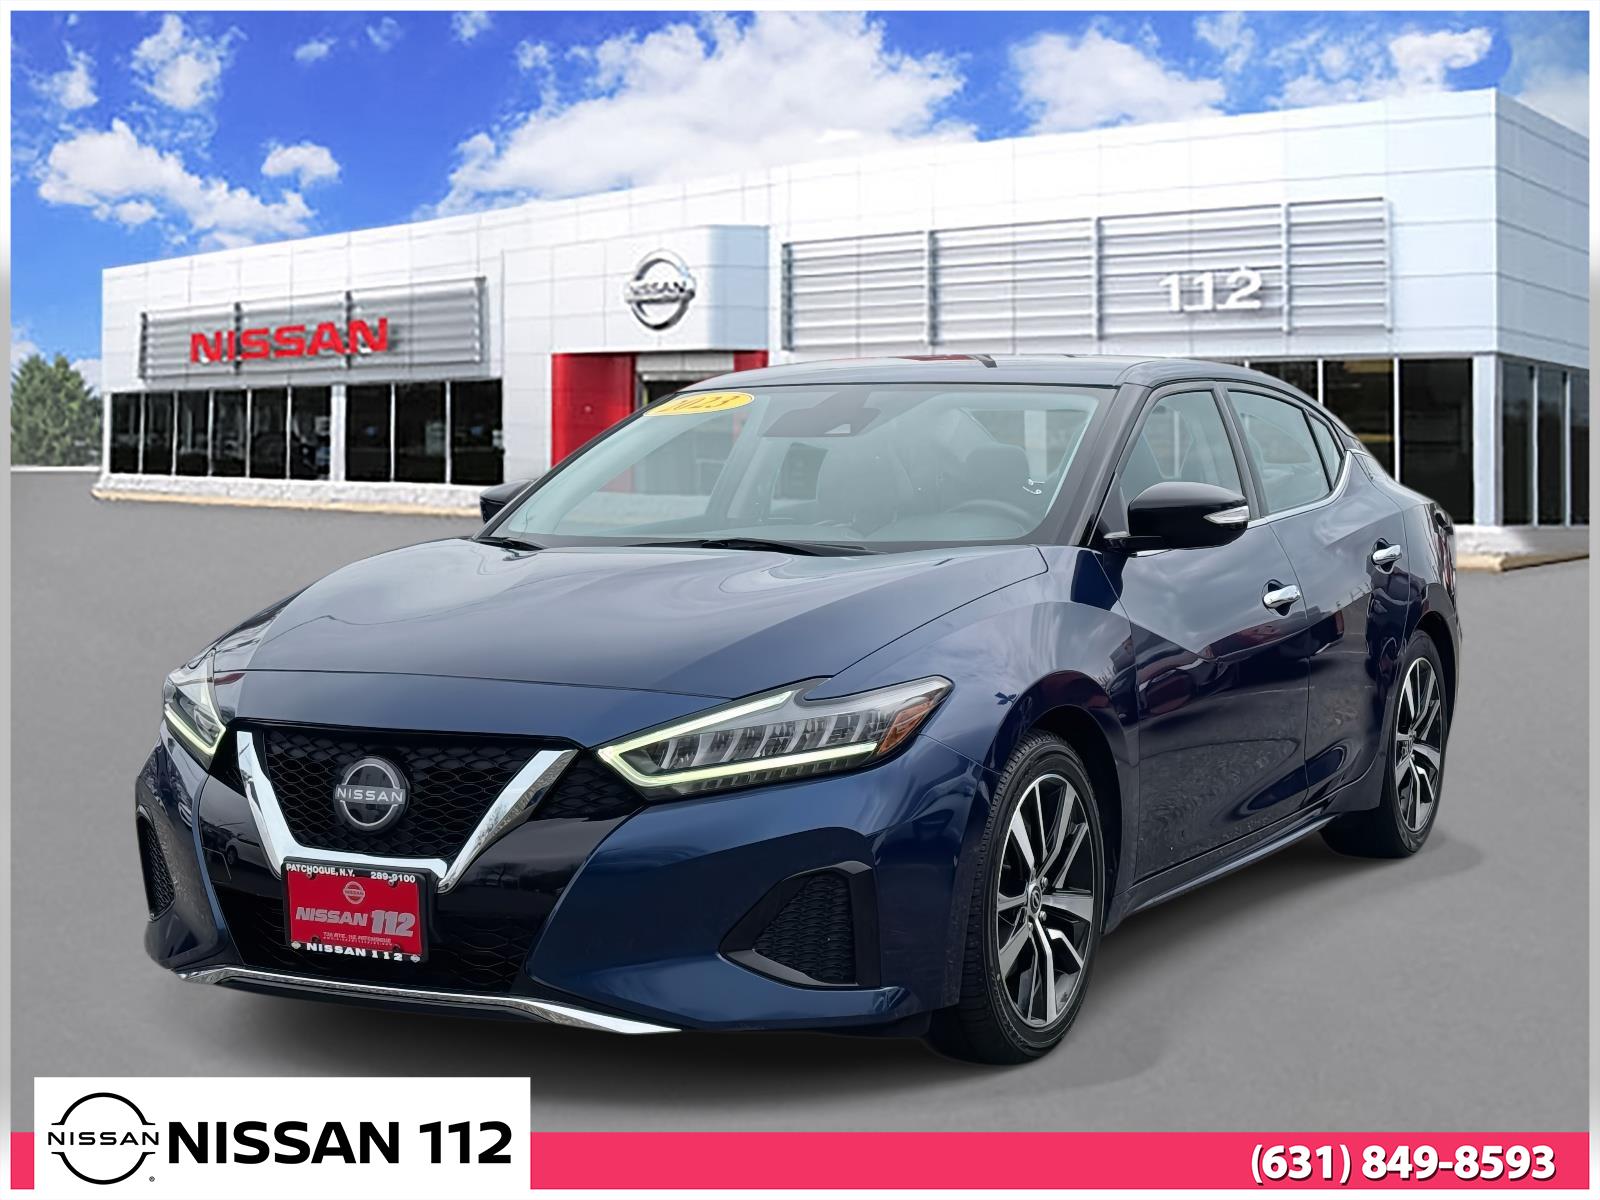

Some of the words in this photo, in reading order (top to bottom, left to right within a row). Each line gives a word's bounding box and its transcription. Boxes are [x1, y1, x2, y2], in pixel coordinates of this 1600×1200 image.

[1159, 270, 1262, 311] 112
[190, 317, 389, 363] NISSAN
[337, 787, 403, 802] NISSAN
[339, 868, 356, 877] N.Y.
[295, 906, 368, 926] NISSAN
[371, 909, 416, 937] 112
[306, 942, 366, 957] NISSAN
